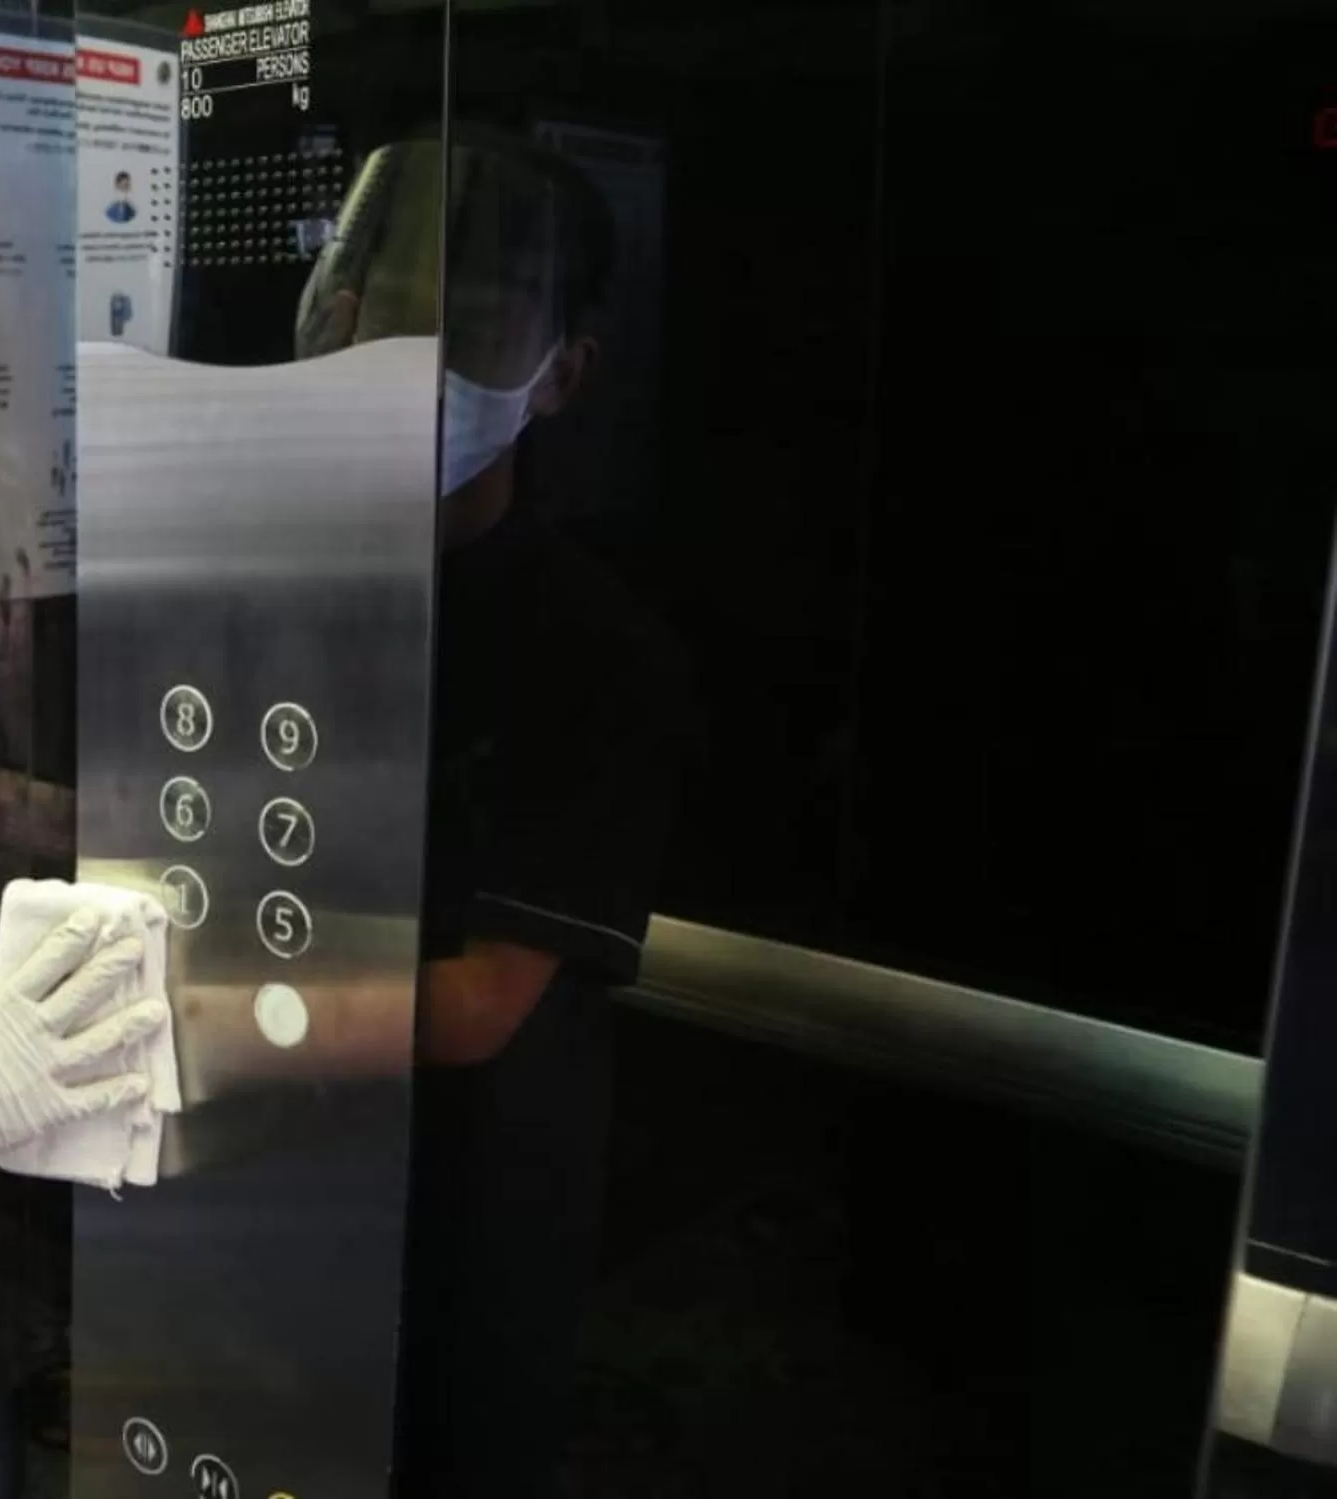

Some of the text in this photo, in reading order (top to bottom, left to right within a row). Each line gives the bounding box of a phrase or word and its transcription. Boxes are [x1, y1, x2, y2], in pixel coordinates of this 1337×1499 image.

[181, 20, 310, 62] PASSENGER ELEVATOR
[181, 51, 310, 91] 10 PERSONS
[181, 95, 213, 120] 800
[291, 82, 310, 111] kg
[176, 702, 196, 736] 8
[279, 719, 300, 755] 9
[175, 793, 194, 828] 6
[276, 813, 298, 848] 7
[176, 884, 189, 914] 1
[273, 907, 294, 942] 5
